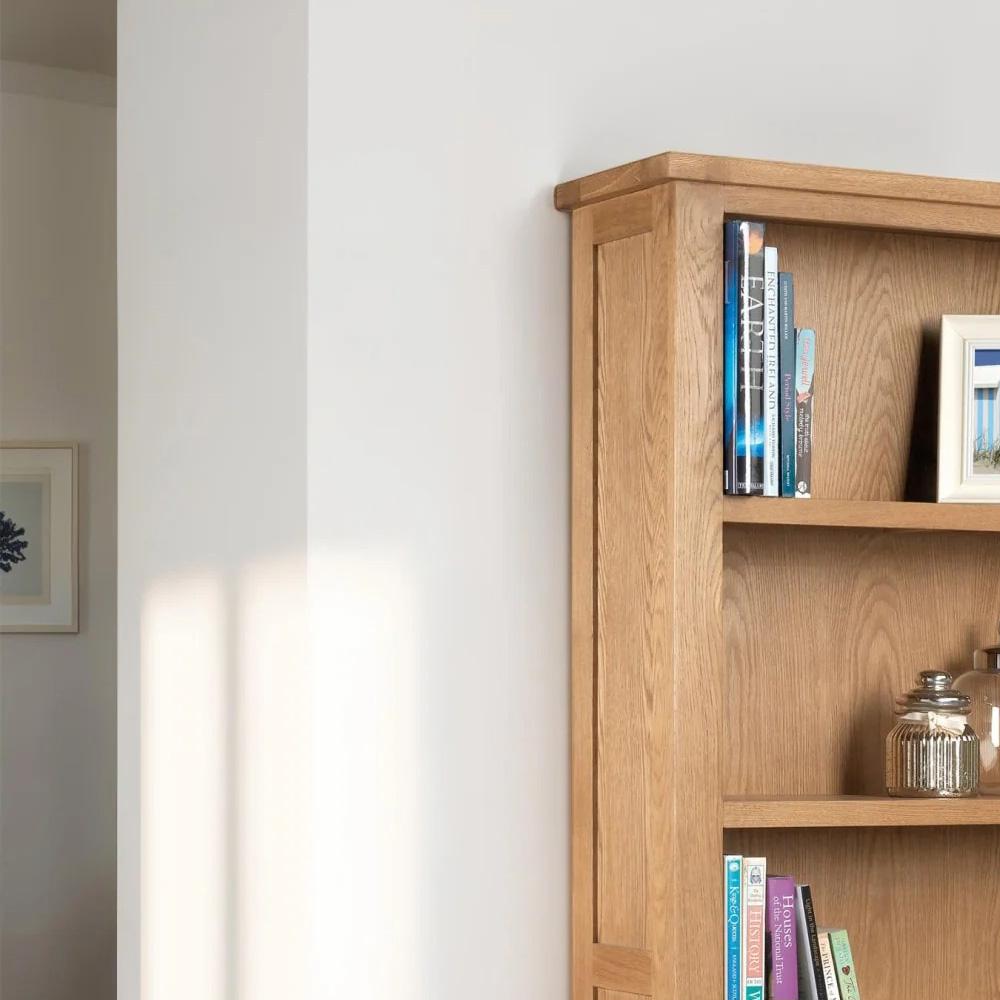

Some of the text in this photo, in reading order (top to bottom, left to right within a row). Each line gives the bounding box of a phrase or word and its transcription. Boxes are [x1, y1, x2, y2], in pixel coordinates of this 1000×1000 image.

[740, 276, 764, 391] EARTH
[767, 271, 776, 410] ENCHANTED IRELAND
[783, 373, 792, 422] Period Style
[773, 896, 780, 906] of
[783, 895, 794, 948] Houses
[749, 910, 762, 974] HISTORY
[776, 963, 784, 984] Trust
[822, 953, 834, 988] PRINCE
